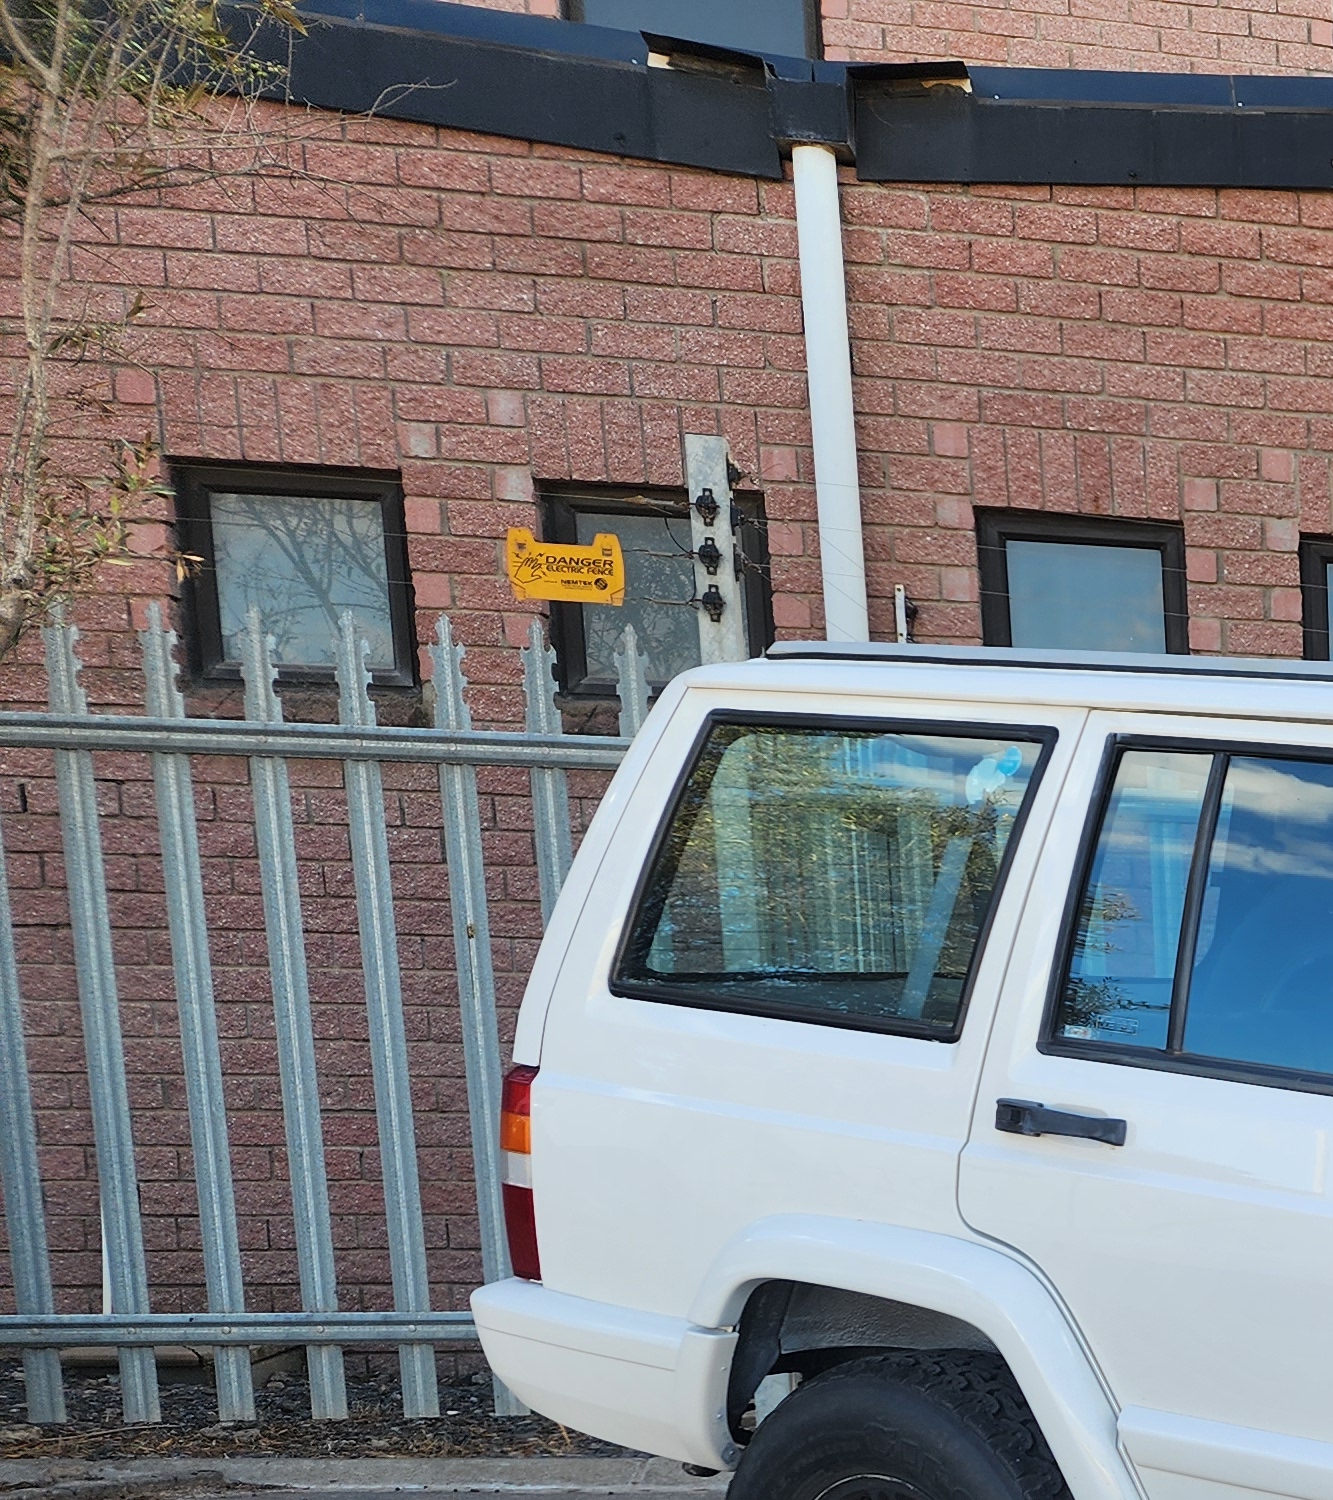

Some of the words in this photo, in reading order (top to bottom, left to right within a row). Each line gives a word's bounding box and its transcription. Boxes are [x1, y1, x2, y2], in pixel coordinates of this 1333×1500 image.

[545, 555, 614, 567] DANGER
[545, 564, 585, 574] ELECTRIC
[586, 566, 614, 576] FENCE
